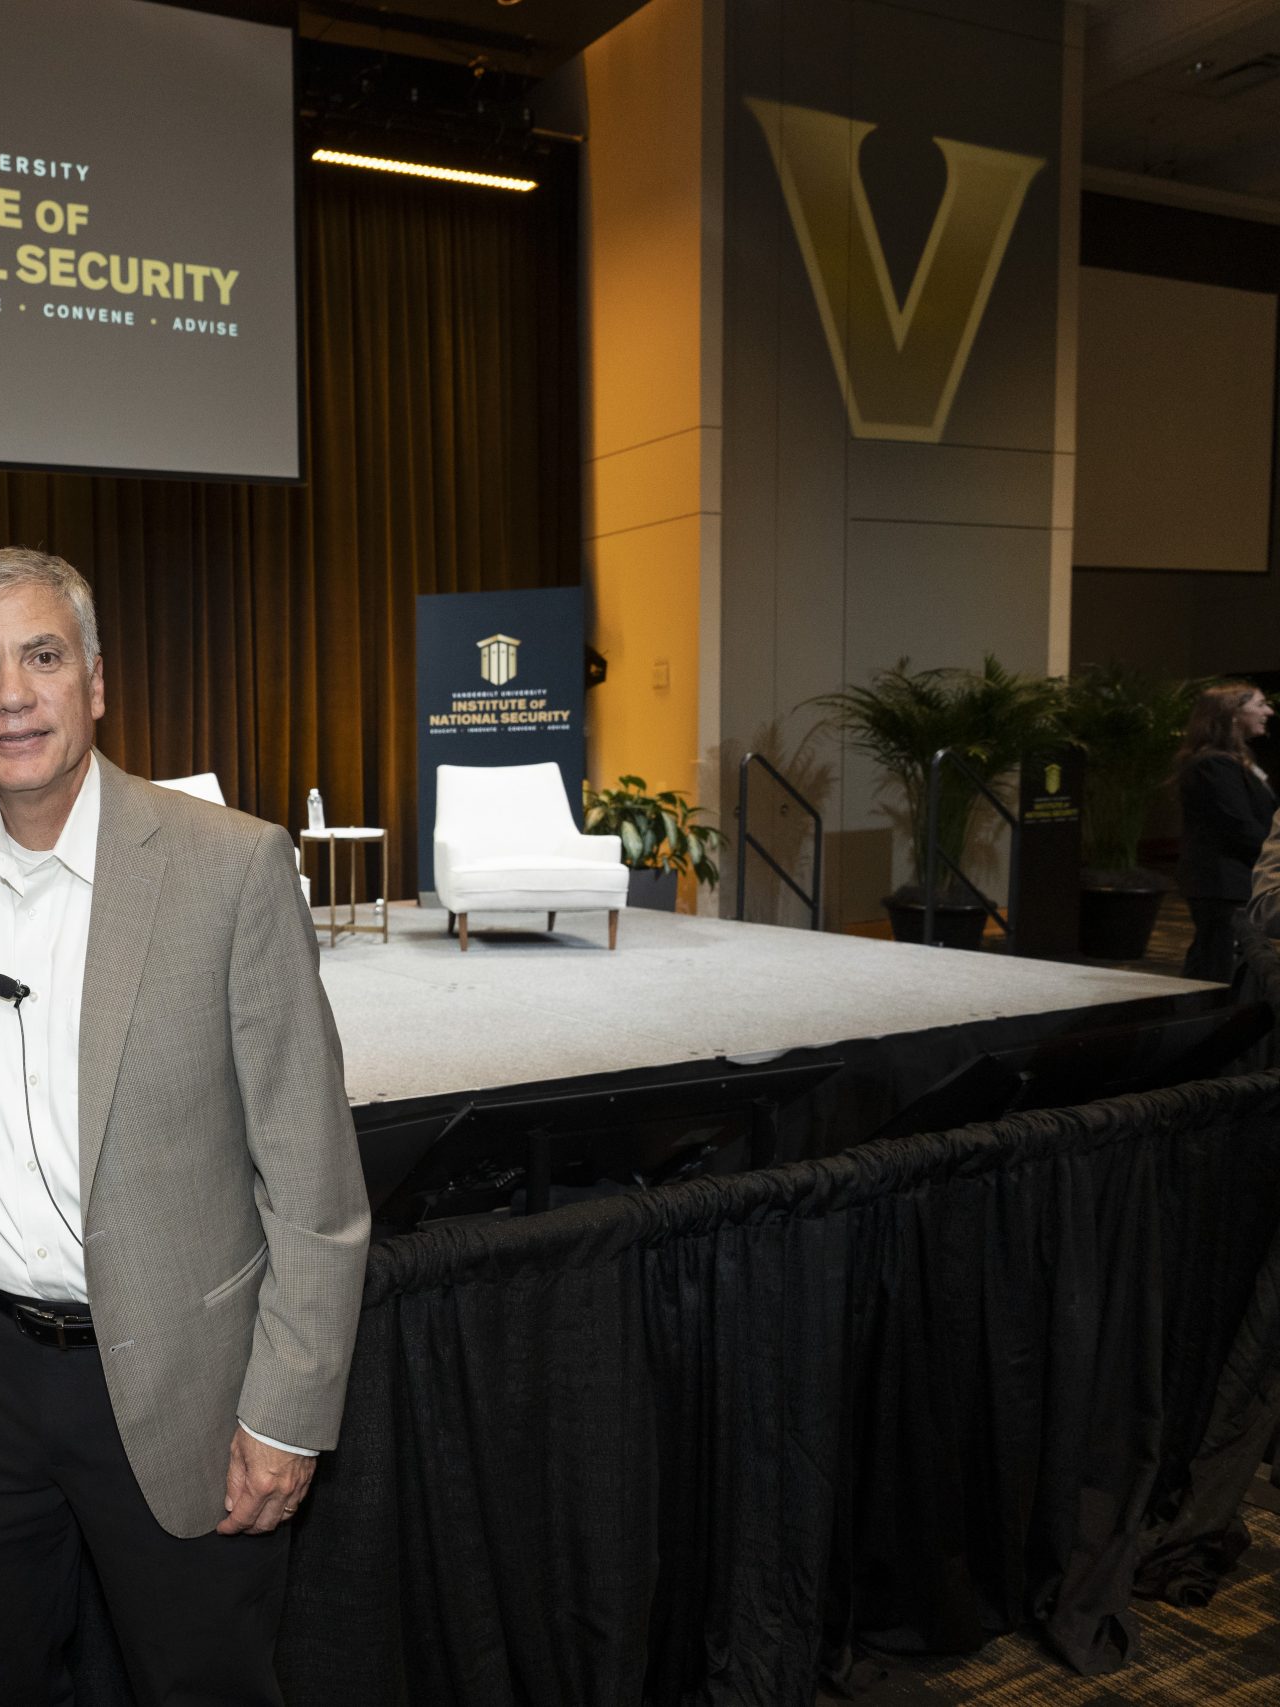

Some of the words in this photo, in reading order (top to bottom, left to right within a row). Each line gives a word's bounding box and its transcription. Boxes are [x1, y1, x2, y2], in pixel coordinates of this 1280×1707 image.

[35, 200, 89, 235] OF
[16, 244, 239, 305] SECURITY
[742, 96, 1048, 443] V
[43, 303, 135, 326] CONVENE
[172, 317, 238, 337] ADVISE
[452, 690, 499, 698] VANDERBILT
[501, 689, 548, 697] UNIVERSITY
[452, 699, 527, 712] INSTITUTE
[529, 699, 547, 710] OF
[429, 713, 499, 726] NATIONAL
[500, 710, 570, 724] SECURITY
